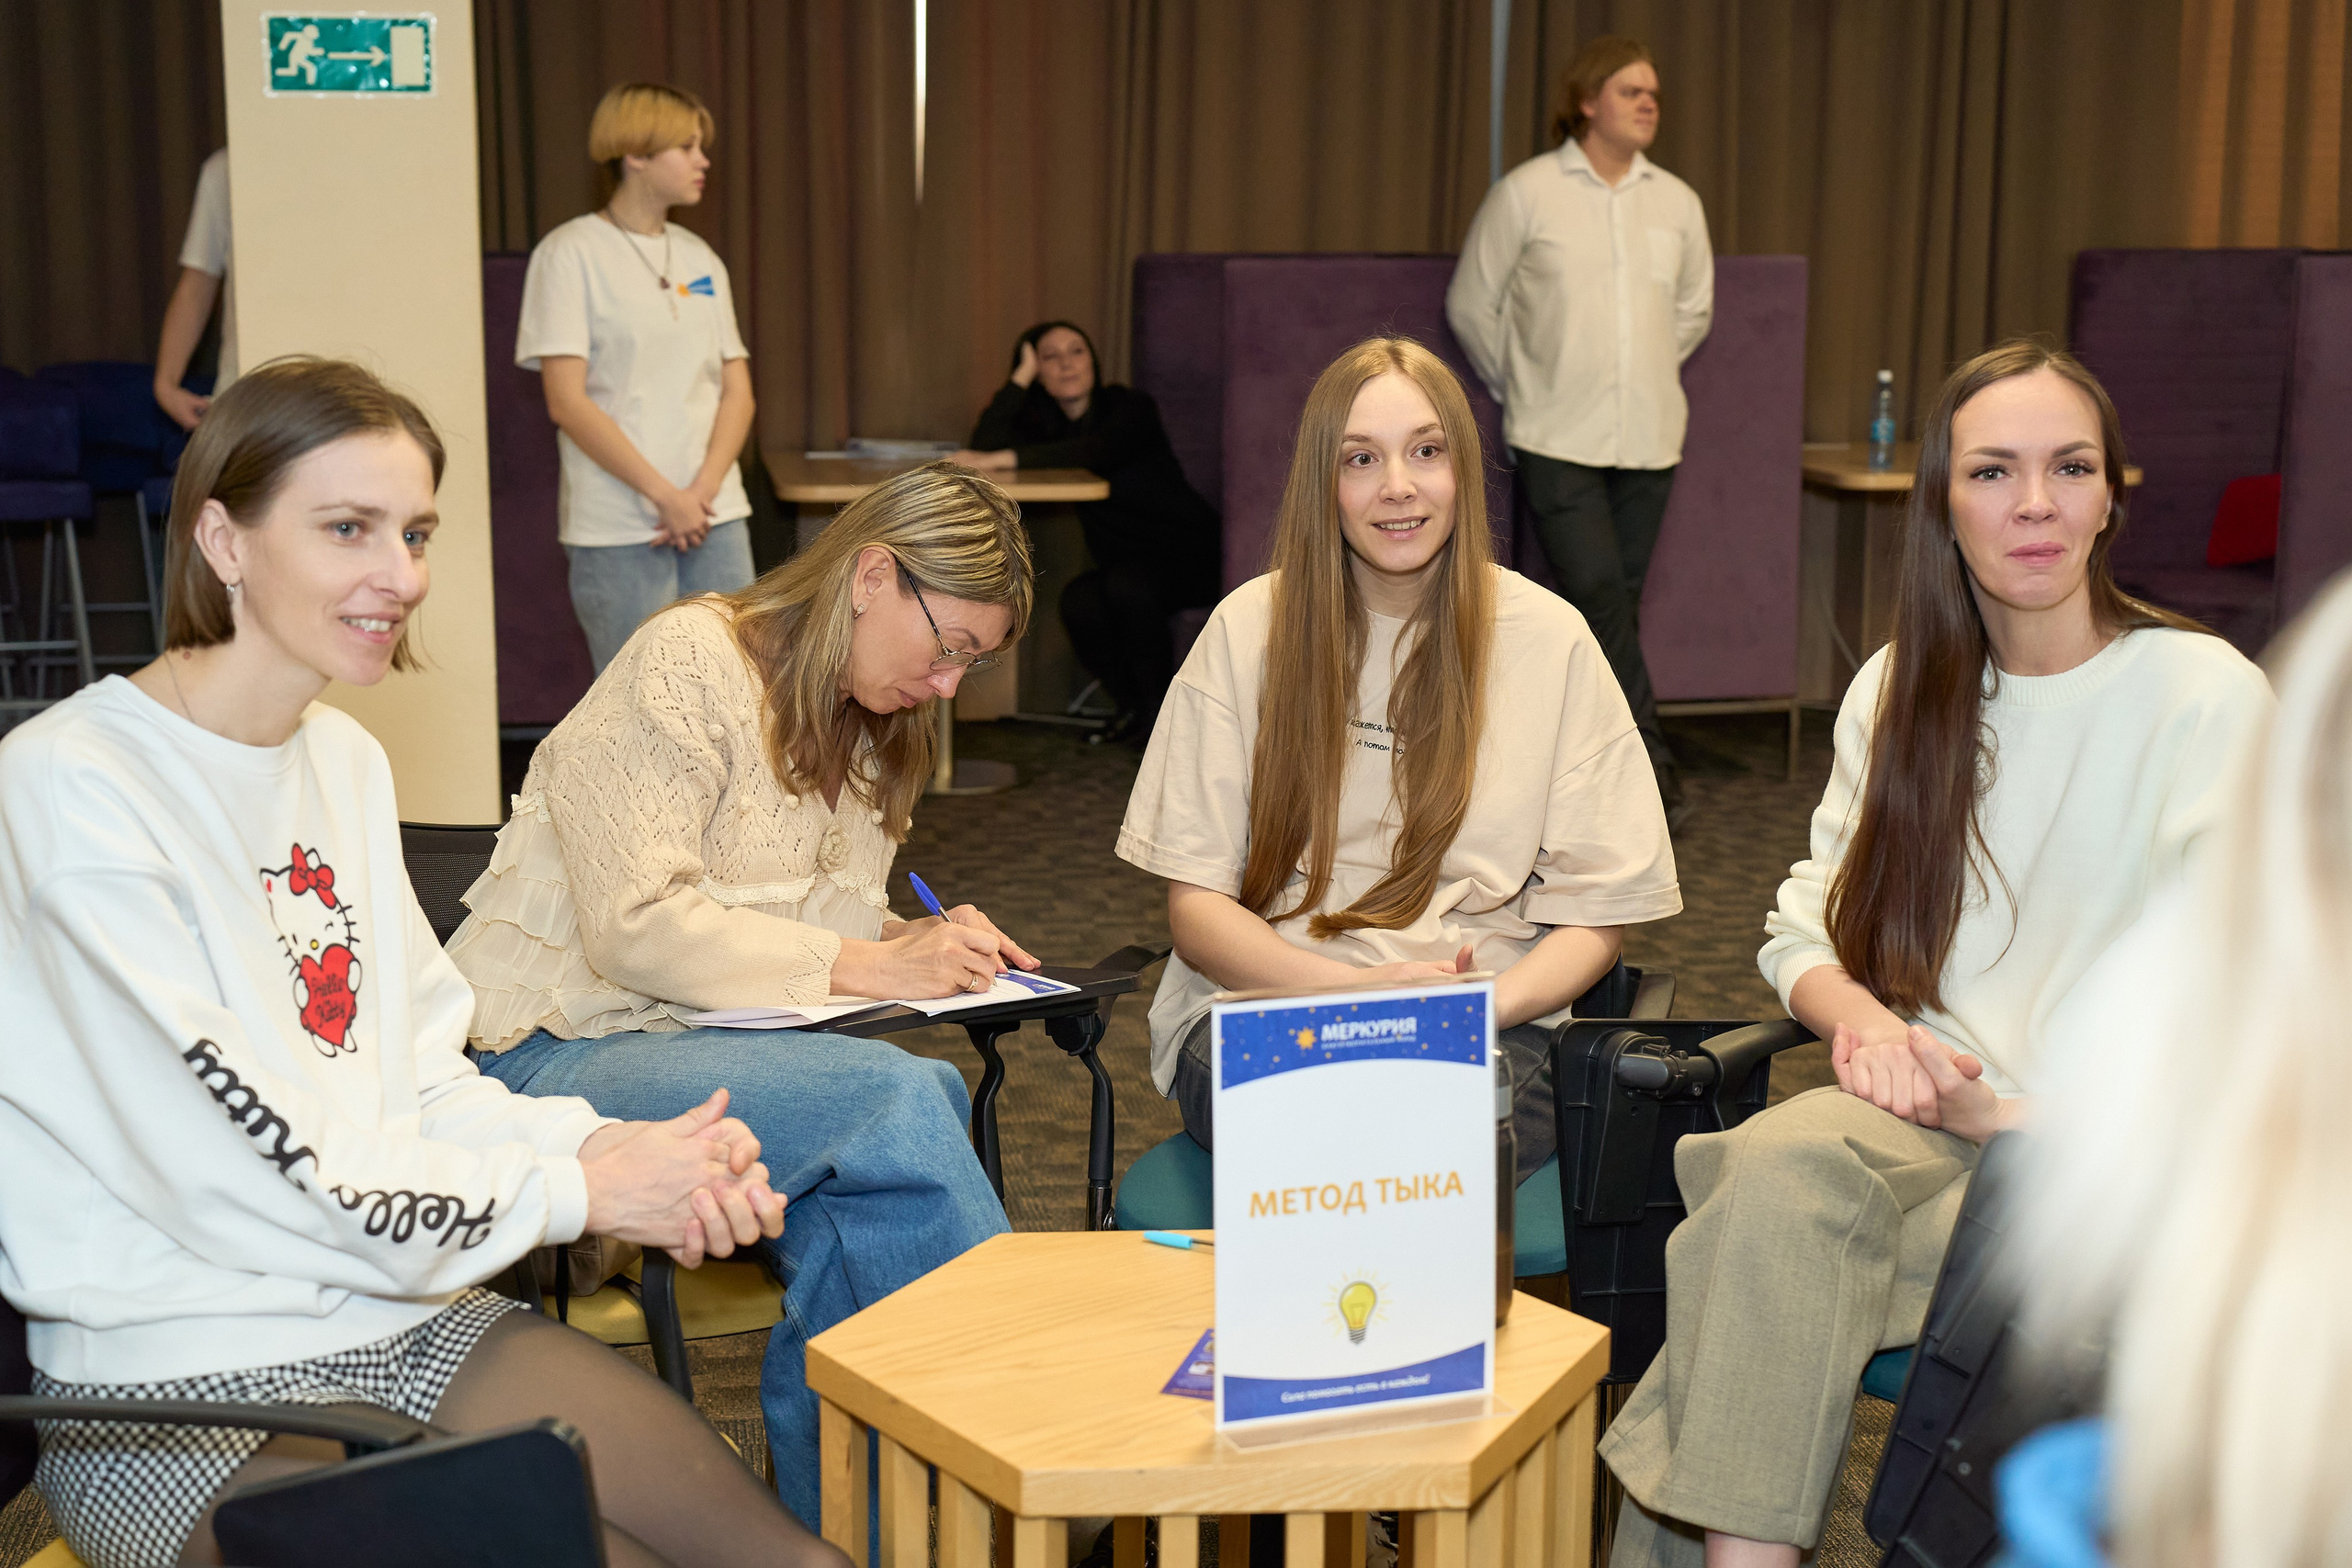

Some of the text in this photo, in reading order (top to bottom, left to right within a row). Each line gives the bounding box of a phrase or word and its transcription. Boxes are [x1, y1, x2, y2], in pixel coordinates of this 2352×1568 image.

[1321, 1016, 1418, 1042] МЕРКУРИЯ
[329, 1184, 496, 1251] Hello
[1250, 1171, 1464, 1218] МЕТОД ТЫКА
